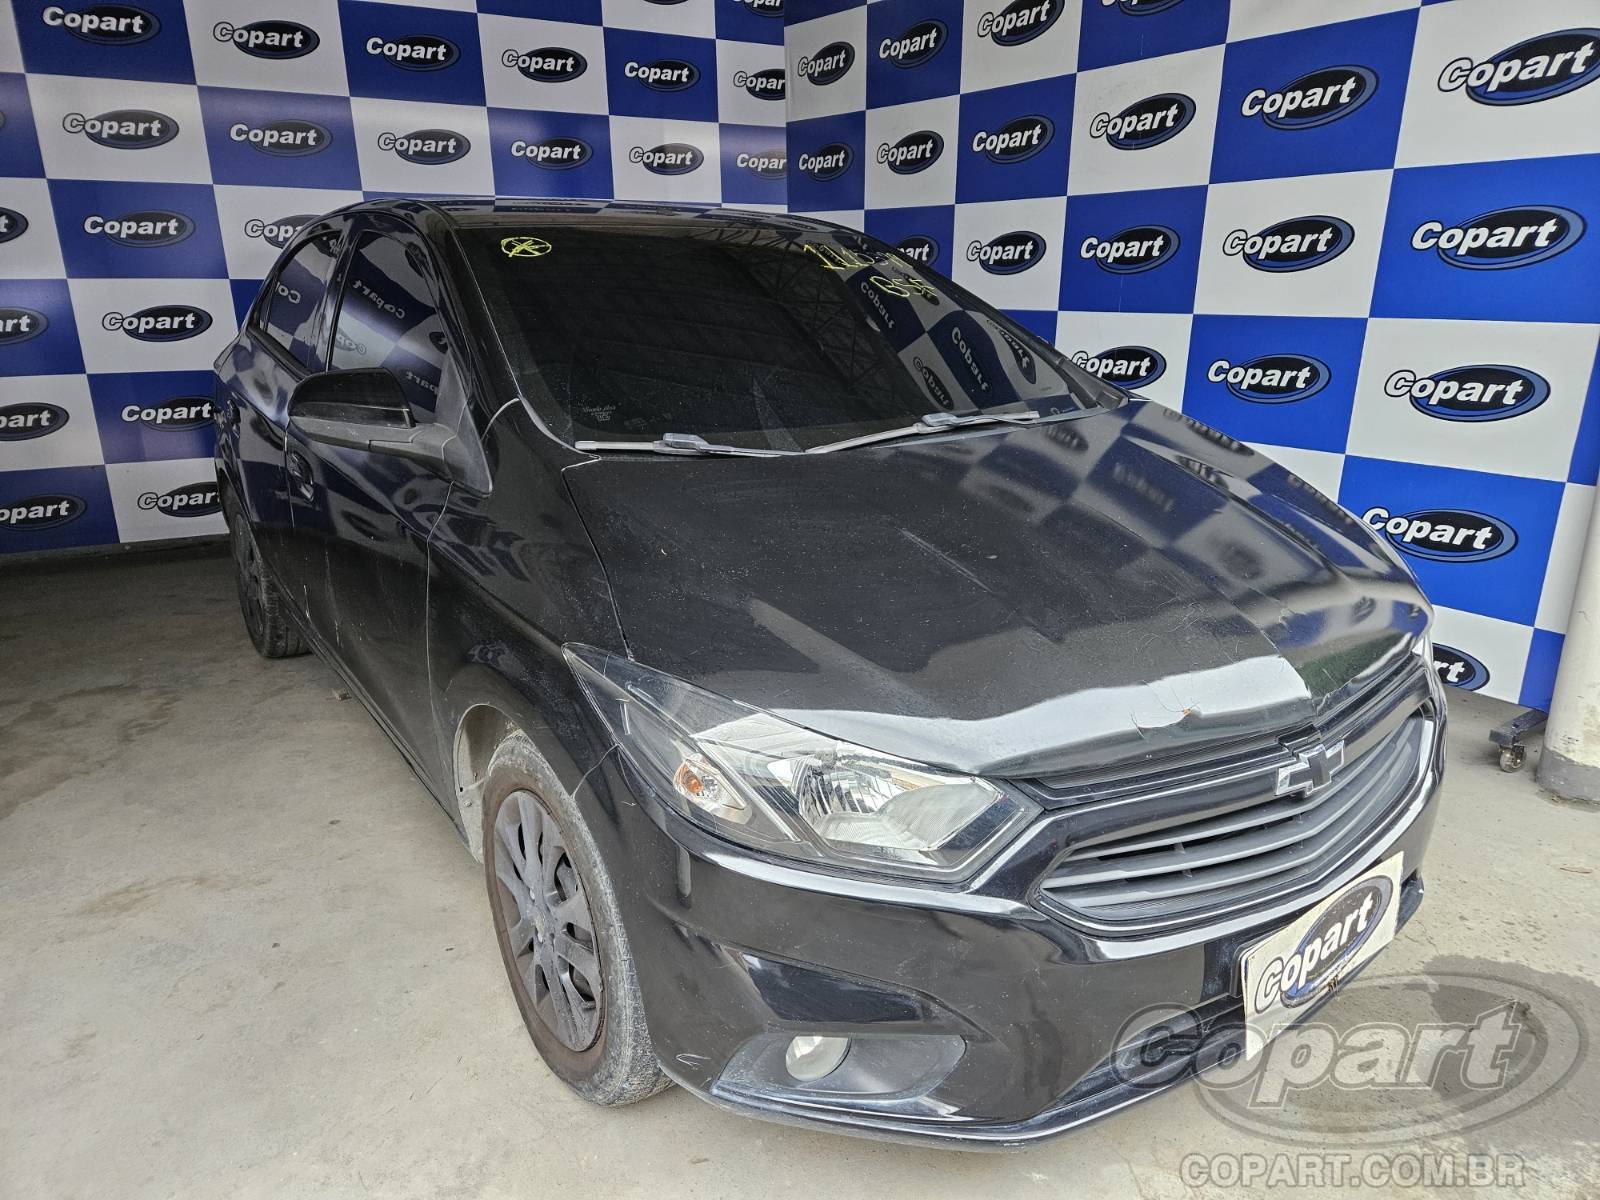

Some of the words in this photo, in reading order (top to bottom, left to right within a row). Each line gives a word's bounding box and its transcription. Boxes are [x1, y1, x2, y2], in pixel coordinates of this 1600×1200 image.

[42, 6, 144, 34] Copart
[977, 0, 1050, 37] Copart
[213, 21, 303, 48] Copart
[879, 28, 937, 62] Copart
[366, 36, 446, 61] Copart
[502, 49, 575, 73] Copart
[624, 61, 690, 83] Copart
[798, 50, 846, 77] Copart
[1437, 41, 1594, 92] Copart
[734, 71, 785, 91] Copar
[1241, 76, 1357, 118] Copart
[62, 112, 162, 138] Copart
[1090, 103, 1180, 138] Copart
[229, 123, 317, 146] Copart
[378, 132, 456, 154] Copart
[973, 124, 1043, 154] Copart
[511, 141, 581, 162] Copart
[629, 147, 693, 167] Copart
[736, 153, 787, 171] Copar
[799, 147, 846, 172] Copart
[877, 139, 934, 165] Copart
[83, 216, 179, 238] Copart
[244, 219, 303, 242] Cop
[1410, 214, 1561, 256] Copart
[966, 240, 1034, 264] Copart
[1080, 233, 1164, 263] Copart
[1222, 227, 1334, 259] Copart
[102, 312, 197, 333] Copart
[1072, 350, 1151, 378] Copart
[1207, 360, 1312, 393] Copart
[1384, 369, 1524, 405] Copart
[121, 401, 211, 424] Copart
[0, 500, 70, 524] opart
[138, 491, 220, 510] Copar
[1361, 506, 1492, 550] Copart
[1255, 892, 1373, 1014] Copart
